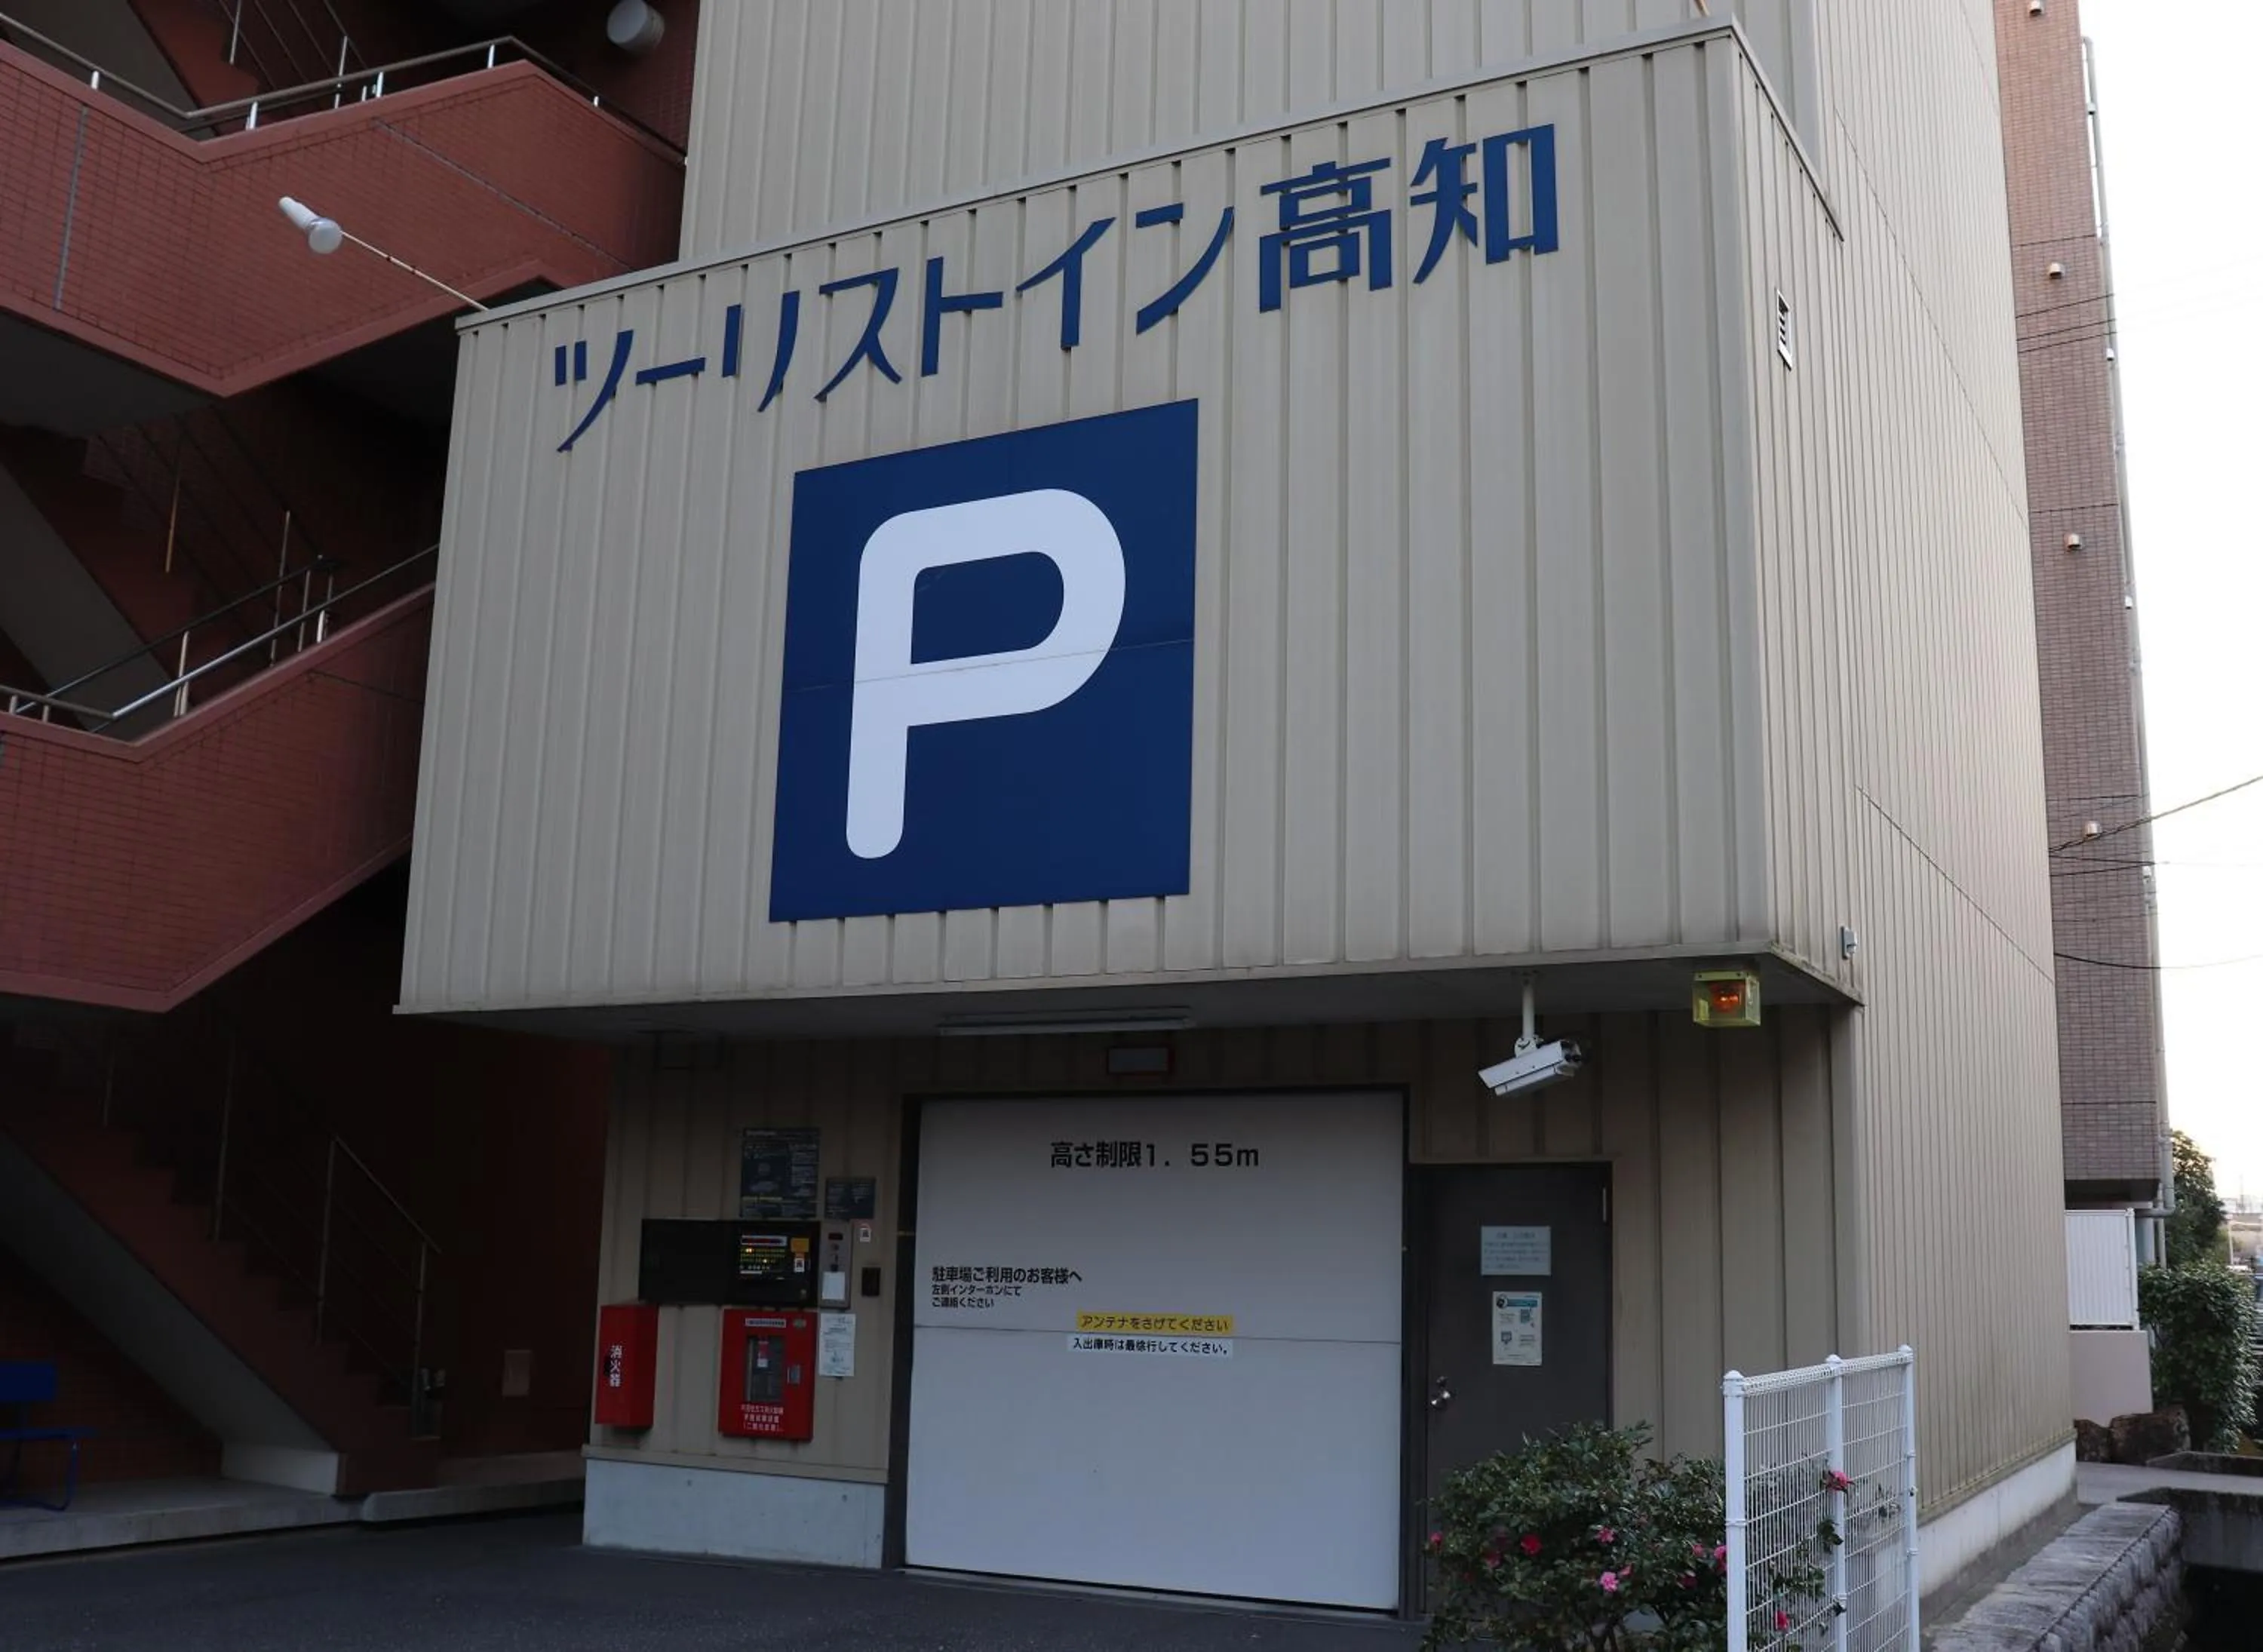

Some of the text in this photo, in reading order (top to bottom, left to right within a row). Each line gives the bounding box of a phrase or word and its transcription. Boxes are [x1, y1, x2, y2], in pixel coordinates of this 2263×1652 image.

[557, 124, 1558, 452] ツーリストイン高知
[846, 488, 1125, 859] P
[932, 1266, 1082, 1284] 駐車場ご利用のお客様へ
[932, 1297, 995, 1309] ご連絡ください
[1081, 1315, 1229, 1333] アンテナをさげてください
[609, 1345, 623, 1388] 消火器
